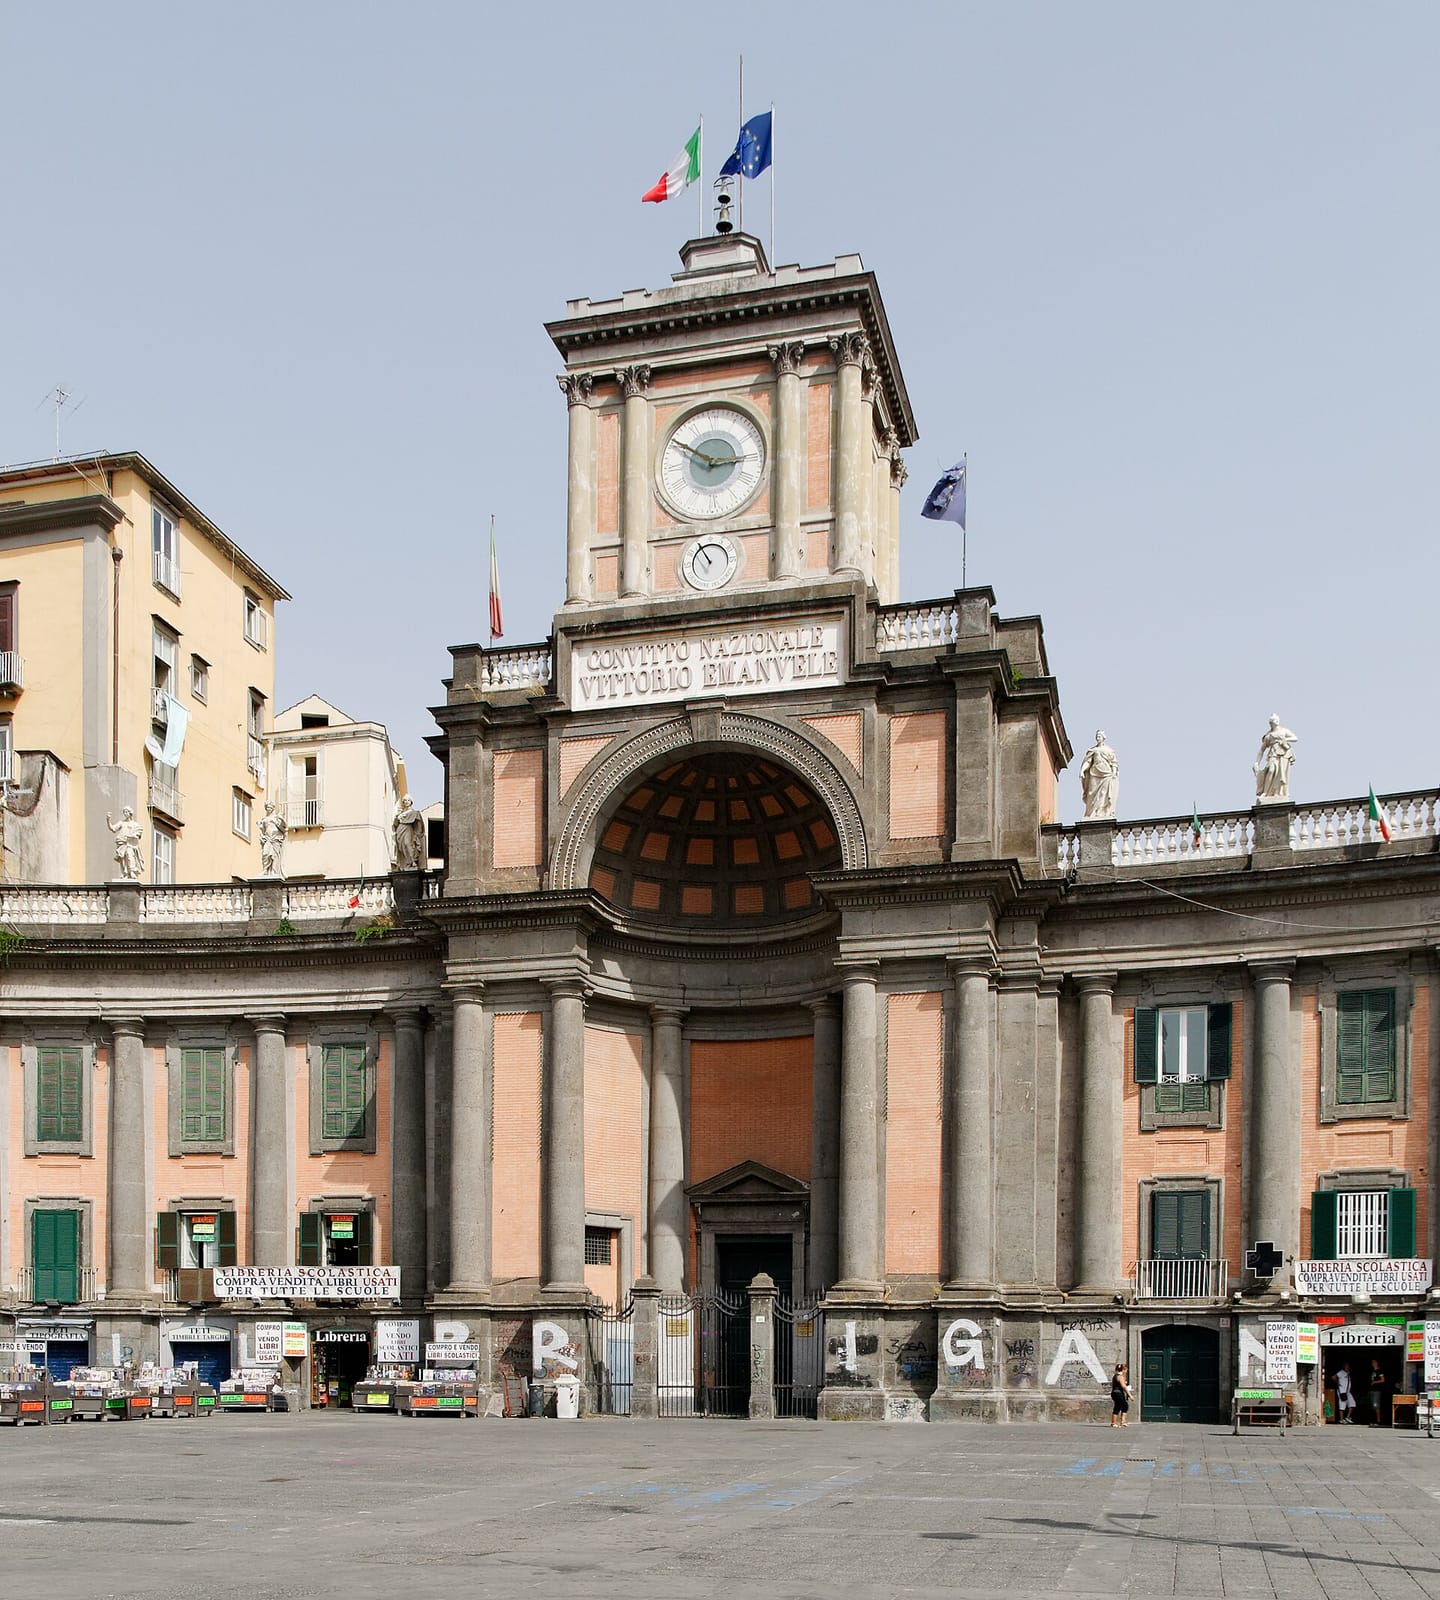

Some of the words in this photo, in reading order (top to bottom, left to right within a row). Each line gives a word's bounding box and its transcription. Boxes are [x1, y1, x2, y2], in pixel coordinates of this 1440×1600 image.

[586, 640, 690, 672] CONVITTO
[699, 626, 824, 661] NAZIONALE
[579, 665, 693, 701] VITTORIO
[702, 651, 838, 688] EMANVELE
[222, 1267, 292, 1277] LIBRERIA
[298, 1267, 392, 1277] SCOLASTICA
[1300, 1262, 1352, 1273] LIBRERIA
[1356, 1261, 1427, 1272] SCOLASTICA
[326, 1277, 357, 1286] LIBRI
[362, 1277, 397, 1286] USATI
[1375, 1272, 1398, 1281] LIBRI
[1401, 1272, 1427, 1281] USATI
[228, 1286, 251, 1295] PER
[261, 1286, 307, 1295] TUTTE
[314, 1286, 330, 1295] LE
[336, 1286, 389, 1295] SCUOLE
[1306, 1282, 1325, 1292] PER
[1329, 1282, 1361, 1292] TUTTE
[1366, 1282, 1377, 1292] LE
[1381, 1281, 1420, 1291] SCUOLE
[315, 1330, 367, 1342] Libreria
[1328, 1331, 1396, 1344] Libreria
[383, 1351, 414, 1360] USATI
[532, 1321, 578, 1370] R
[943, 1319, 985, 1369] G
[1045, 1329, 1110, 1385] A
